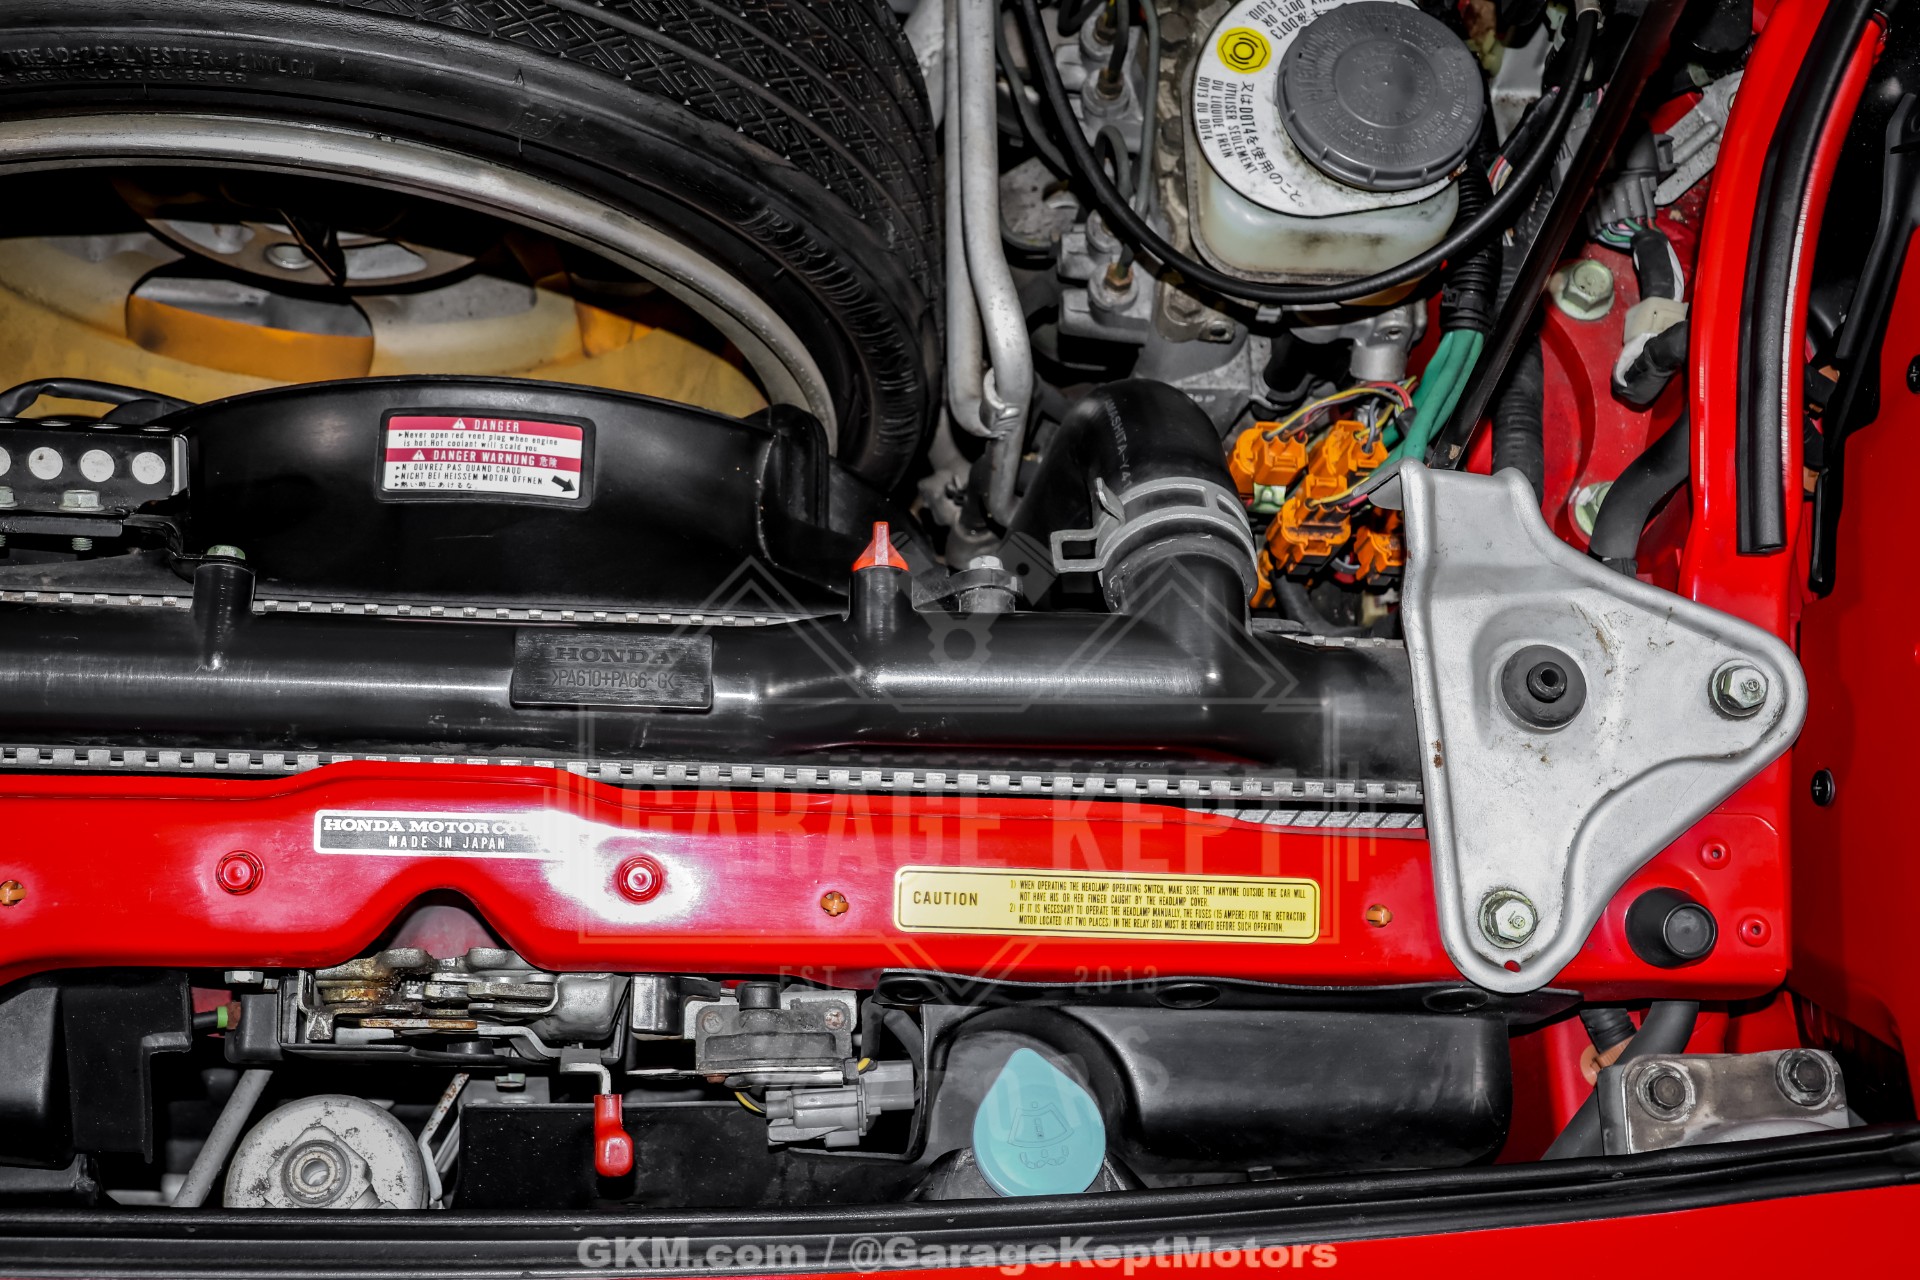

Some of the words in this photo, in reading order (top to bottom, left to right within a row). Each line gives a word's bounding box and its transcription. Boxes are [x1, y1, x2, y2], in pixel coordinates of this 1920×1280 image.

[1278, 0, 1305, 18] DOT3
[1262, 14, 1278, 28] OR
[1197, 76, 1210, 98] DOT3
[1212, 80, 1224, 91] DU
[1196, 102, 1208, 113] OU
[1224, 82, 1238, 120] UTILISER
[1210, 96, 1224, 128] LIQUIDE
[1216, 133, 1234, 158] FREIN
[1228, 125, 1259, 174] SEULEMENT
[474, 419, 520, 432] DANGER
[404, 431, 427, 439] Never
[430, 432, 448, 440] open
[489, 434, 506, 442] plug
[532, 437, 558, 446] engine
[448, 440, 477, 448] coolant
[433, 450, 476, 461] DANGER
[482, 452, 535, 466] WARNUNG
[540, 456, 558, 468] 危険
[400, 472, 424, 480] NICHT
[428, 472, 440, 480] BEI
[444, 472, 478, 480] HEISSEM
[482, 474, 508, 482] MOTOR
[466, 464, 492, 472] QUAND
[496, 465, 522, 474] CHAUD
[554, 647, 672, 664] HONDA
[323, 818, 405, 832] HONDA
[409, 821, 489, 834] MOTOR
[389, 836, 428, 848] MADE
[438, 836, 452, 848] IN
[463, 837, 505, 849] JAPAN
[1020, 880, 1035, 890] WHEN
[1038, 881, 1067, 891] OPERATING
[1070, 882, 1079, 891] THE
[1081, 882, 1109, 892] HEADLAMP
[1112, 883, 1141, 893] OPERATING
[1144, 884, 1166, 894] SWITCH,
[1168, 885, 1182, 895] MAKE
[1186, 886, 1199, 895] SURE
[1203, 886, 1215, 895] THAT
[1218, 886, 1239, 896] ANYONE
[1242, 887, 1264, 897] OUTSIDE
[1267, 888, 1277, 898] THE
[1280, 889, 1290, 898] CAR
[1294, 889, 1306, 898] WILL
[913, 890, 978, 906] CAUTION
[1020, 892, 1030, 901] NOT
[1033, 893, 1046, 902] HAVE
[1050, 893, 1059, 902] HIS
[1062, 893, 1070, 902] OR
[1074, 894, 1084, 903] HER
[1088, 894, 1107, 904] FINGER
[1110, 895, 1132, 904] CAUGHT
[1134, 895, 1142, 904] BY
[1146, 896, 1156, 905] THE
[1159, 896, 1186, 906] HEADLAMP
[1019, 904, 1025, 913] IF
[1027, 904, 1032, 913] IT
[1035, 904, 1040, 913] IS
[1044, 904, 1074, 915] NECESSARY
[1077, 905, 1083, 915] TO
[1086, 905, 1108, 916] OPERATE
[1111, 906, 1120, 916] THE
[1123, 906, 1150, 917] HEADLAMP
[1152, 907, 1181, 918] MANUALLY,
[1183, 908, 1193, 918] THE
[1195, 909, 1212, 918] FUSES
[1213, 909, 1222, 919] (15
[1224, 910, 1247, 920] AMPERE)
[1249, 911, 1259, 920] FOR
[1262, 911, 1272, 920] THE
[1276, 912, 1307, 922] RETRACTOR
[1019, 915, 1037, 925] MOTOR
[1040, 916, 1062, 926] LOCATED
[1064, 917, 1073, 926] (AT
[1075, 917, 1087, 926] TWO
[1089, 917, 1111, 927] PLACES)
[1114, 918, 1119, 927] IN
[1122, 918, 1131, 928] THE
[1133, 918, 1149, 928] RELAY
[1152, 919, 1162, 928] BOX
[1165, 920, 1179, 929] MUST
[1181, 920, 1187, 930] BE
[1190, 921, 1214, 931] REMOVED
[1216, 921, 1235, 931] BEFORE
[1237, 922, 1252, 932] SUCH
[1254, 922, 1284, 932] OPERATION.
